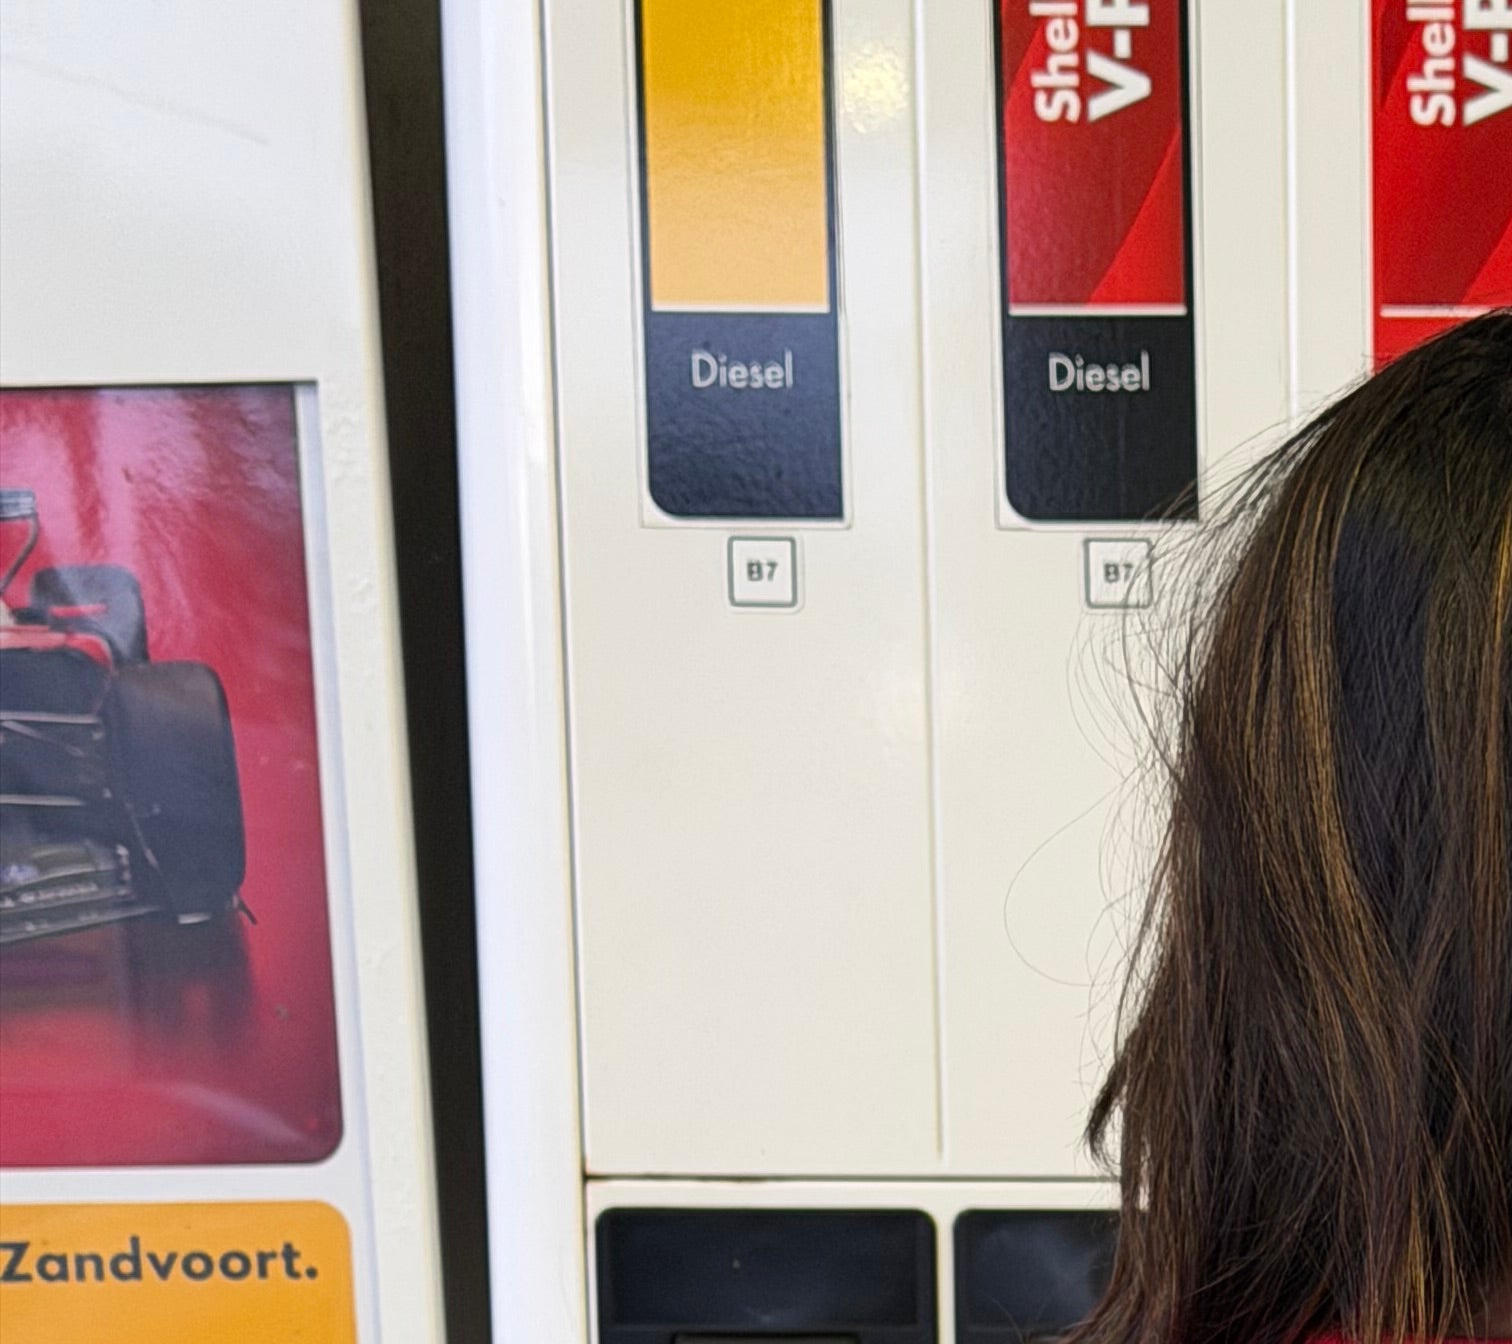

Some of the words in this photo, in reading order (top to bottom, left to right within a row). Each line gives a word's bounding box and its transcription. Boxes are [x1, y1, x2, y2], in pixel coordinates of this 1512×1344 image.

[690, 349, 794, 390] Diesel
[1048, 351, 1151, 392] Diesel
[746, 560, 778, 582] B7
[1104, 563, 1135, 585] B7
[0, 1235, 319, 1283] Zandvoort.
